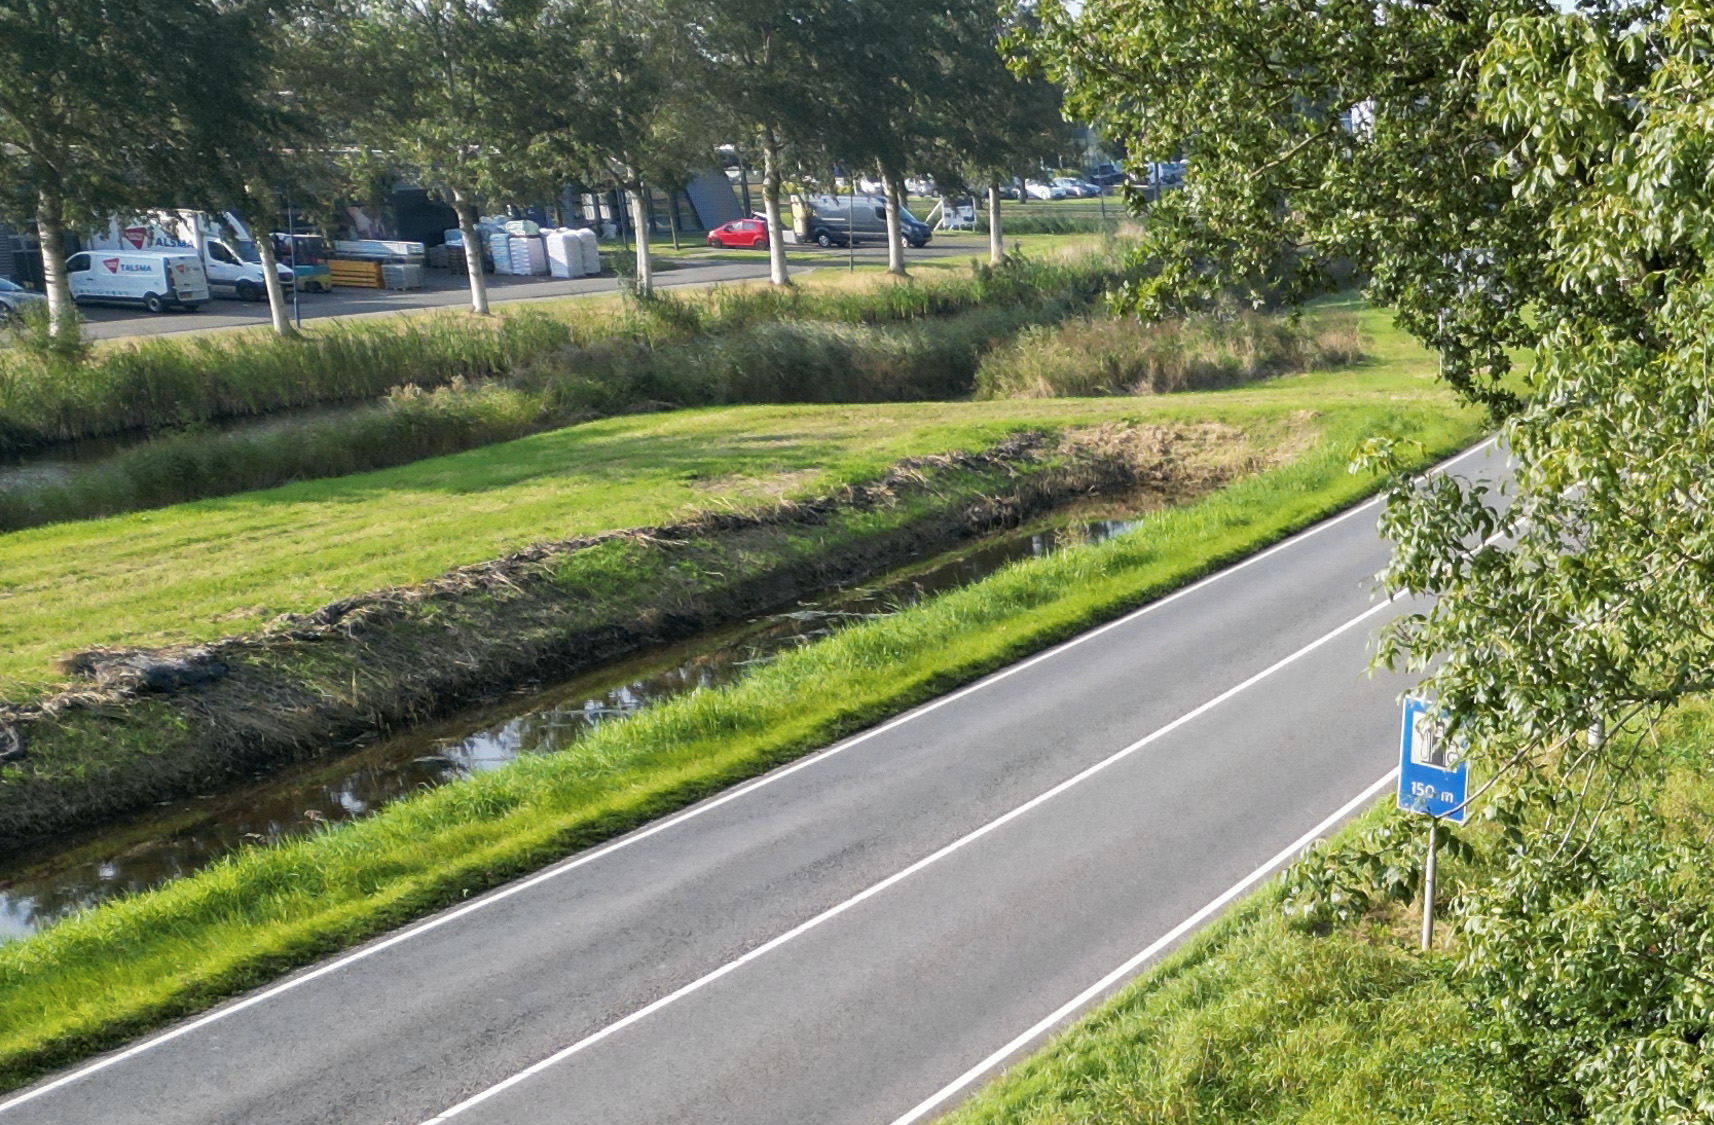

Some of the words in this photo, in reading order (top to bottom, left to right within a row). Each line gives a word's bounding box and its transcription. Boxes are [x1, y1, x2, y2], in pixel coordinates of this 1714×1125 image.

[120, 264, 152, 272] TALSMA
[1411, 781, 1436, 799] 150
[1441, 791, 1454, 803] m
